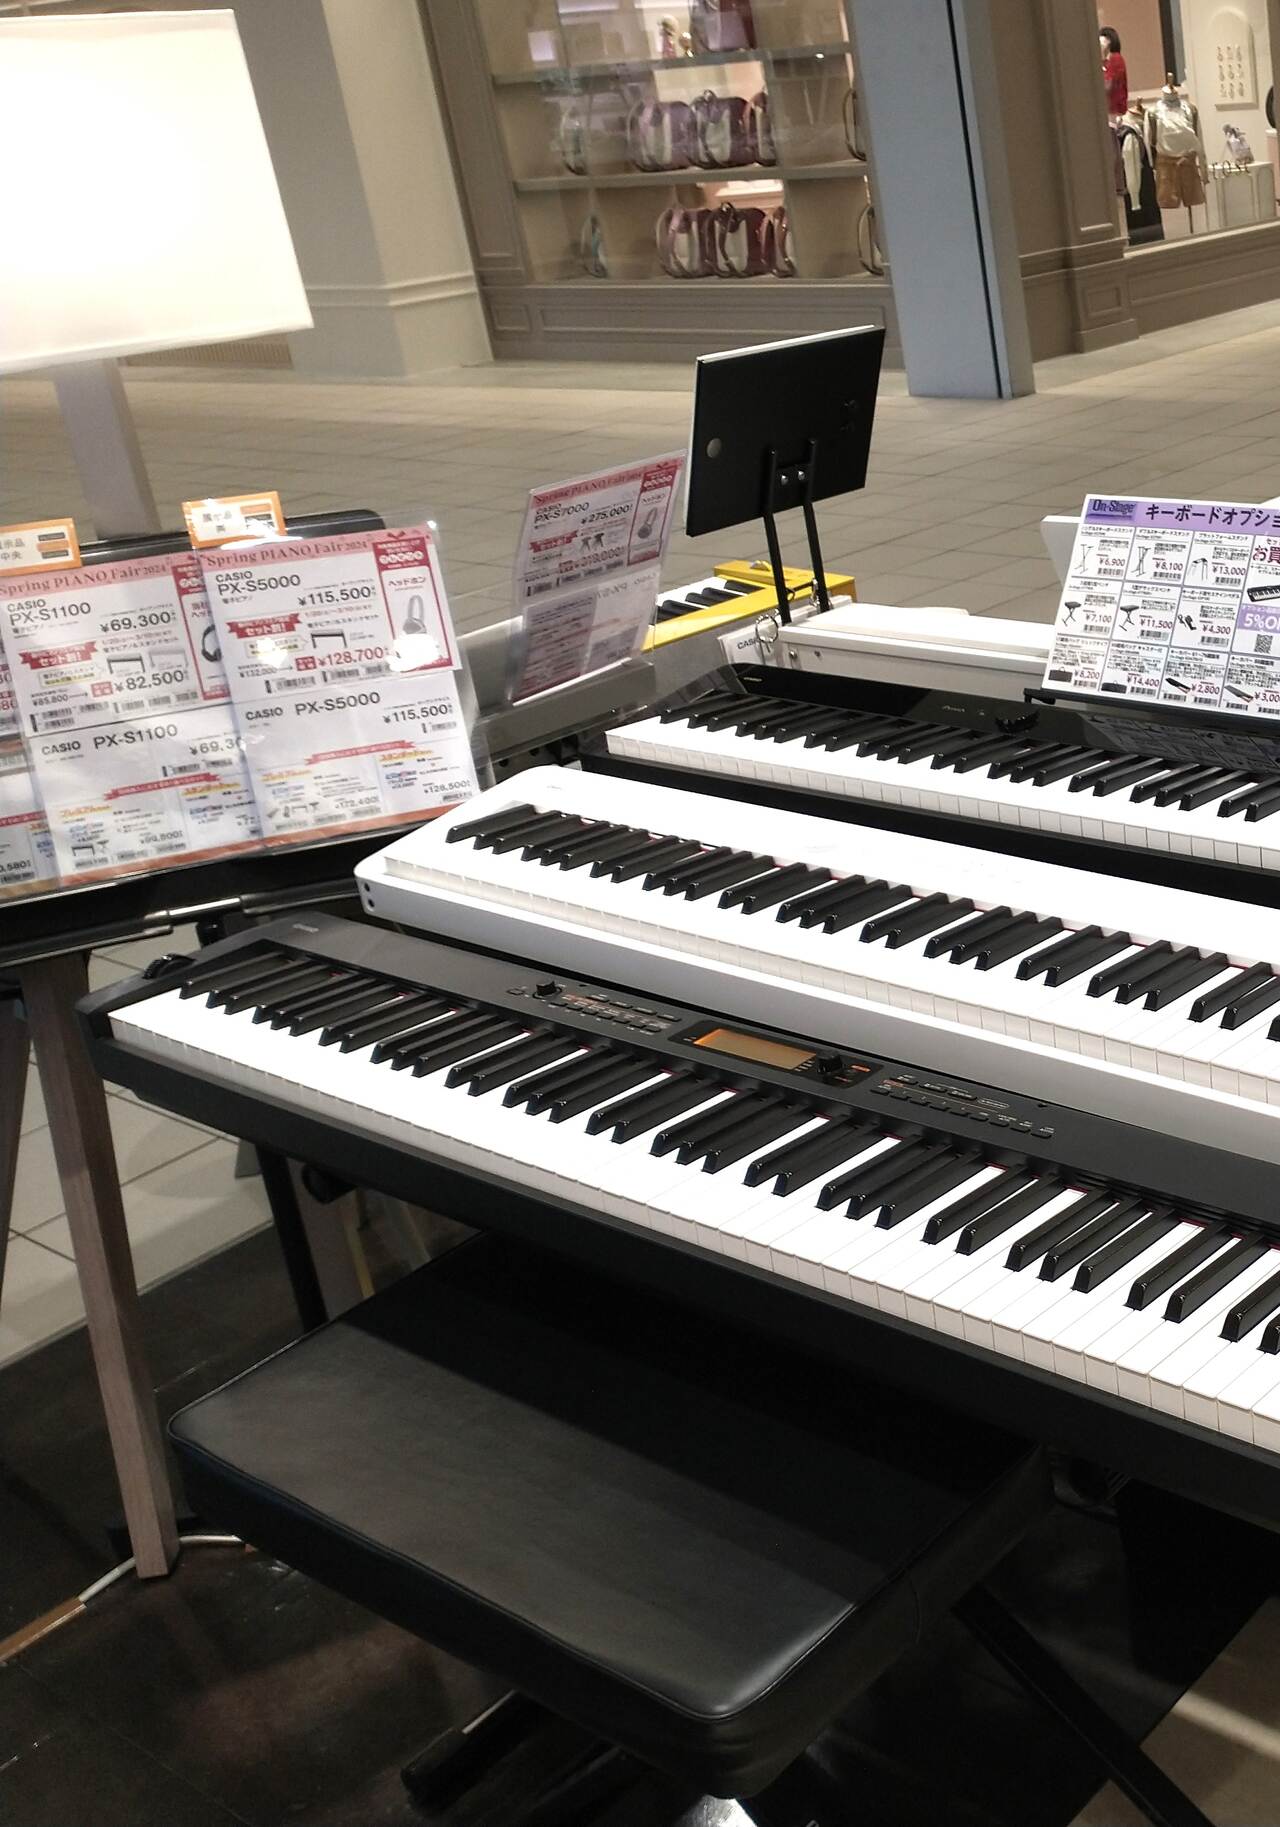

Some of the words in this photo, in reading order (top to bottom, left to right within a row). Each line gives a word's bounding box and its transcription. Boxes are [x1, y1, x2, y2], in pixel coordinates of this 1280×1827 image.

[534, 502, 590, 524] PX-S7000
[1092, 499, 1135, 514] On-Stage
[207, 552, 256, 568] Spring
[261, 545, 312, 561] PIANO
[315, 541, 344, 554] Fair
[1155, 560, 1184, 572] ¥8,100
[1211, 565, 1247, 576] ¥13,000
[0, 578, 50, 597] Spring
[54, 571, 107, 587] PIANO
[112, 567, 142, 581] Fair
[216, 571, 253, 582] CASIO
[218, 574, 301, 596] PX-S5000
[7, 599, 46, 613] CASIO
[9, 602, 91, 626] PX-S1100
[1085, 613, 1112, 624] ¥7,100
[1139, 618, 1173, 630] ¥11,500
[1202, 624, 1231, 635] ¥4,300
[1126, 675, 1160, 687] ¥14,400
[1191, 684, 1220, 695] ¥2,800
[245, 707, 283, 721] CASIO
[295, 692, 381, 716] PX-S5000
[41, 741, 81, 756] CASIO
[93, 724, 178, 750] PX-S1100
